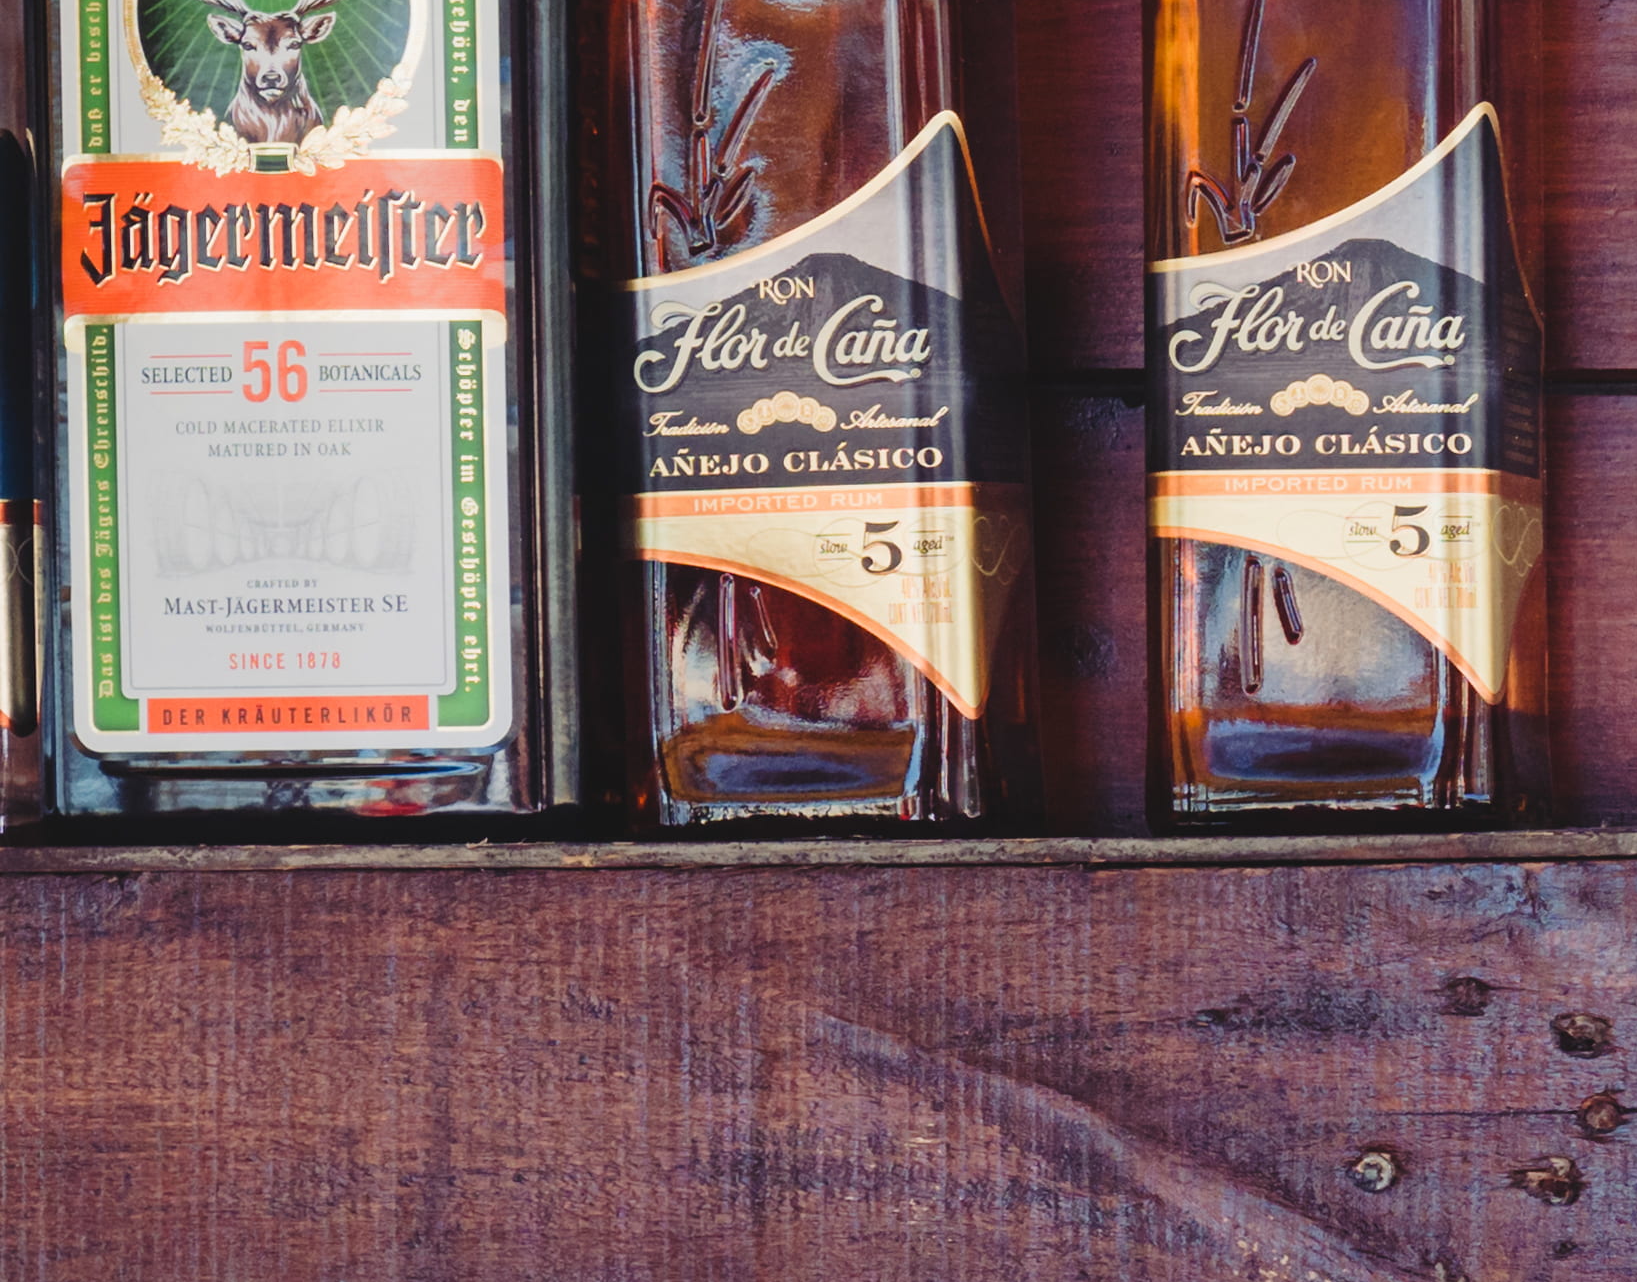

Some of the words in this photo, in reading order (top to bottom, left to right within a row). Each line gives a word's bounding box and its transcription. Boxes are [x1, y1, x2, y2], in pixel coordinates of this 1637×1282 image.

[90, 75, 102, 96] er
[453, 98, 472, 143] den
[1296, 261, 1352, 288] RON
[757, 276, 816, 305] RON
[1168, 282, 1304, 373] Flor
[1309, 305, 1347, 341] de
[1349, 281, 1466, 370] Caña
[634, 300, 768, 393] Flor
[773, 321, 811, 358] de
[813, 294, 931, 386] Caña
[141, 366, 233, 385] SELECTED
[241, 339, 309, 403] 56
[318, 364, 423, 382] BOTANICALS
[456, 328, 478, 441] Schöpfer
[1176, 390, 1263, 416] Tradición
[1372, 389, 1479, 415] Artesanal
[175, 420, 218, 436] COLD
[223, 418, 322, 435] MACERATED
[328, 418, 385, 433] ELIXIR
[643, 410, 730, 437] Tradición
[840, 404, 949, 431] Artesanal
[208, 442, 288, 458] MATURED
[294, 442, 312, 457] IN
[318, 441, 352, 457] OAK
[1180, 428, 1301, 456] AÑEJO
[1315, 425, 1473, 455] CLÁSICO
[460, 454, 479, 483] im
[649, 448, 770, 478] AÑEJO
[783, 442, 944, 473] CLÁSICO
[1225, 477, 1348, 492] IMPORTED
[1361, 476, 1413, 491] RUM
[694, 495, 818, 512] IMPORTED
[831, 493, 883, 508] RUM
[95, 480, 113, 557] Jägers
[1348, 522, 1378, 536] slow
[1389, 505, 1431, 558] 5
[459, 497, 482, 622] Geschöpfe
[820, 539, 849, 554] slow
[861, 521, 903, 575] 5
[97, 568, 112, 603] des
[246, 579, 299, 589] CRAFTED
[304, 578, 318, 588] BY
[381, 594, 409, 613] SE
[97, 613, 112, 642] ist
[306, 622, 366, 633] GERMANY
[98, 653, 114, 698] Das
[229, 653, 286, 670] SINCE
[297, 652, 342, 670] 1878
[163, 708, 205, 726] DER
[222, 703, 412, 725] KRÄUTERLIKÖR
